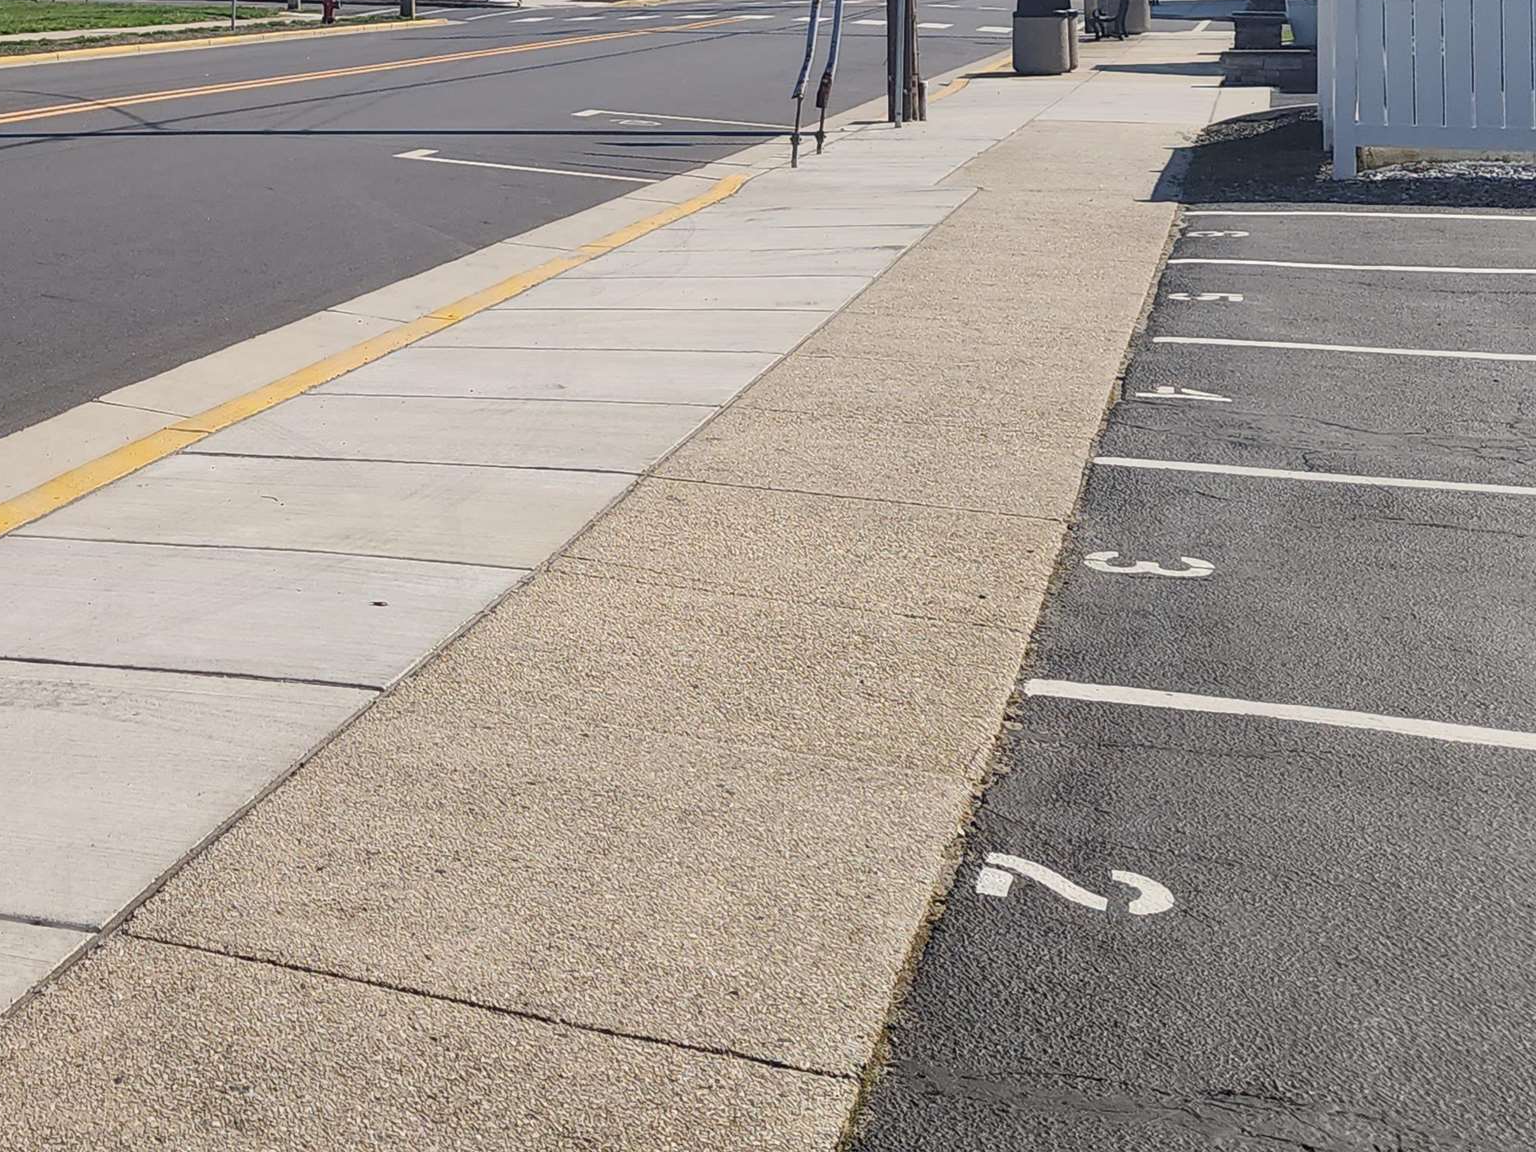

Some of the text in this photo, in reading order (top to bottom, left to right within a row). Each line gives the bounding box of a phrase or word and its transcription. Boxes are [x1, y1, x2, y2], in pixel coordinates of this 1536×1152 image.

[1168, 293, 1244, 302] 5
[1135, 385, 1232, 402] 4
[1084, 550, 1216, 577] 3
[976, 851, 1175, 916] 2
